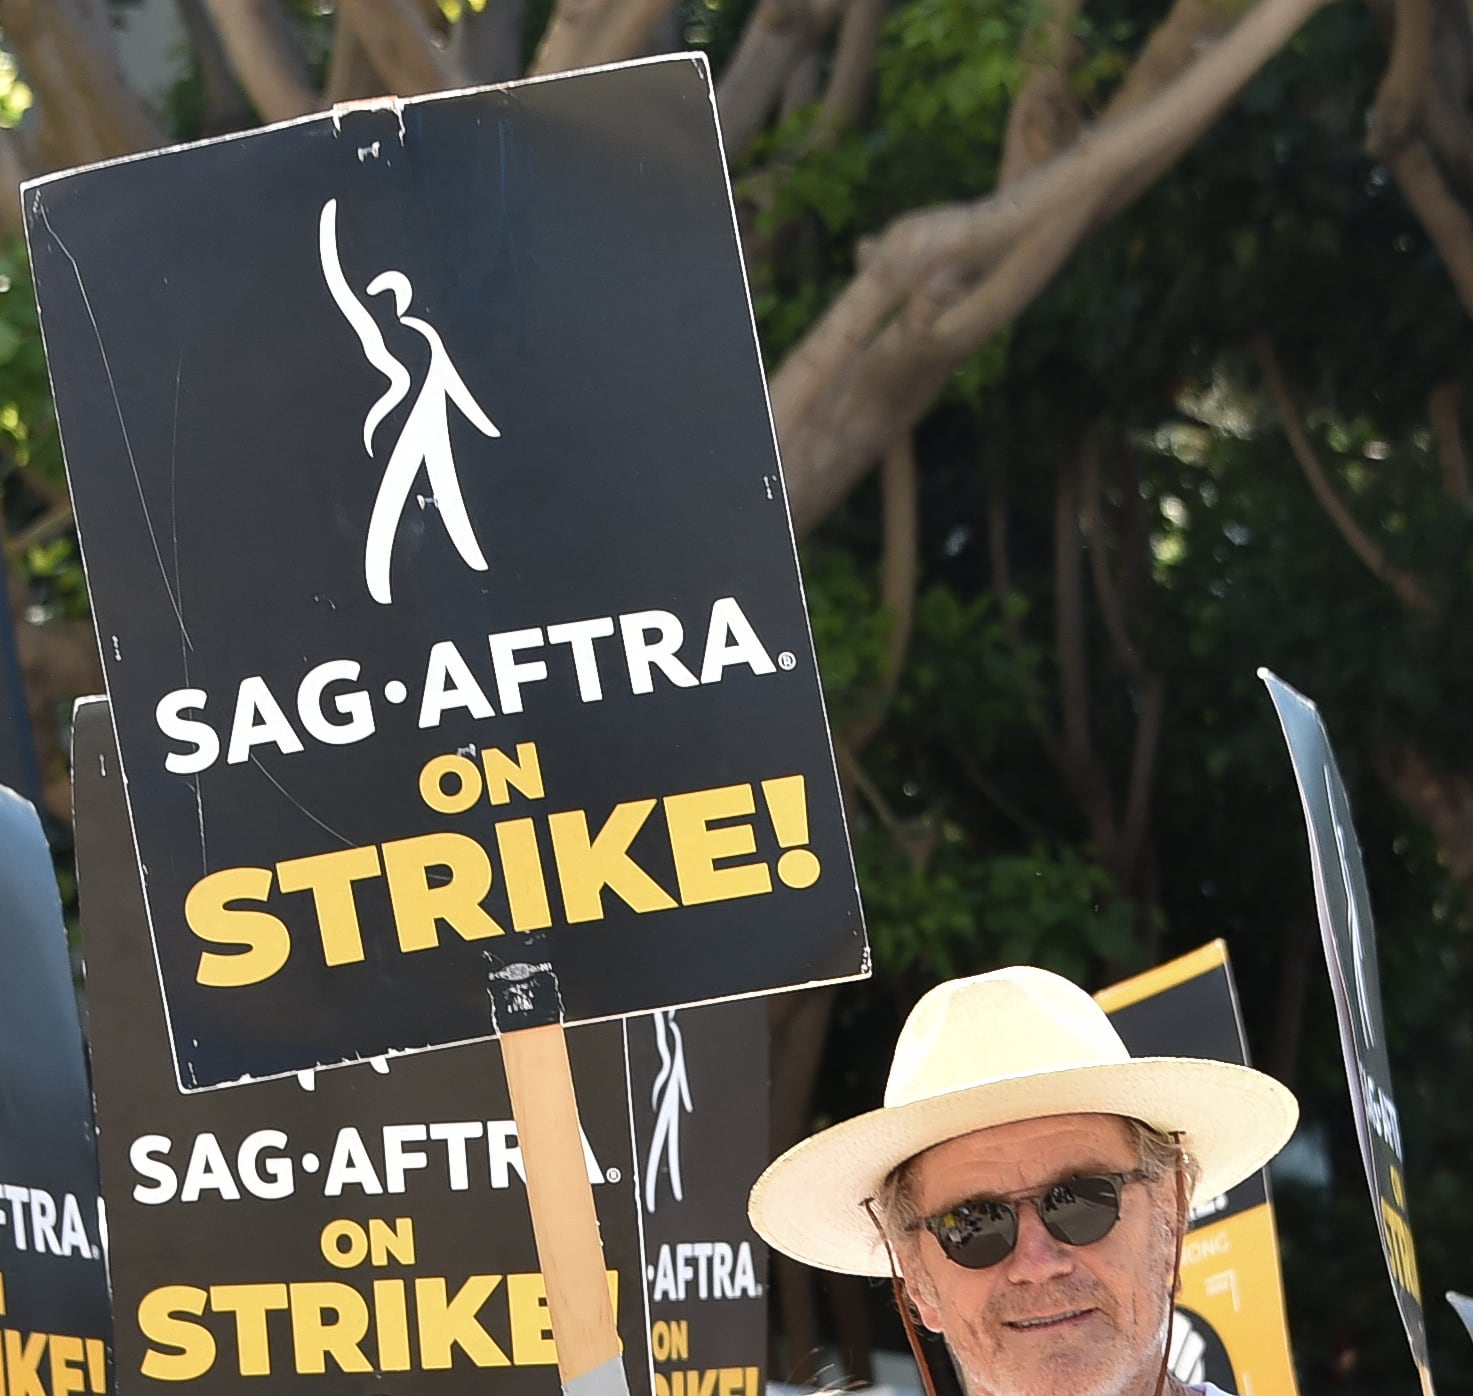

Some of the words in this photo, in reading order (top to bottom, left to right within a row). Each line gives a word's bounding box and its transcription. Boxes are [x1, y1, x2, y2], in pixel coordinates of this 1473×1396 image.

[419, 741, 545, 815] ON
[184, 774, 822, 988] STRIKE!
[320, 1217, 416, 1269] ON
[138, 1270, 624, 1381] STRIKE
[652, 1320, 688, 1361] ON
